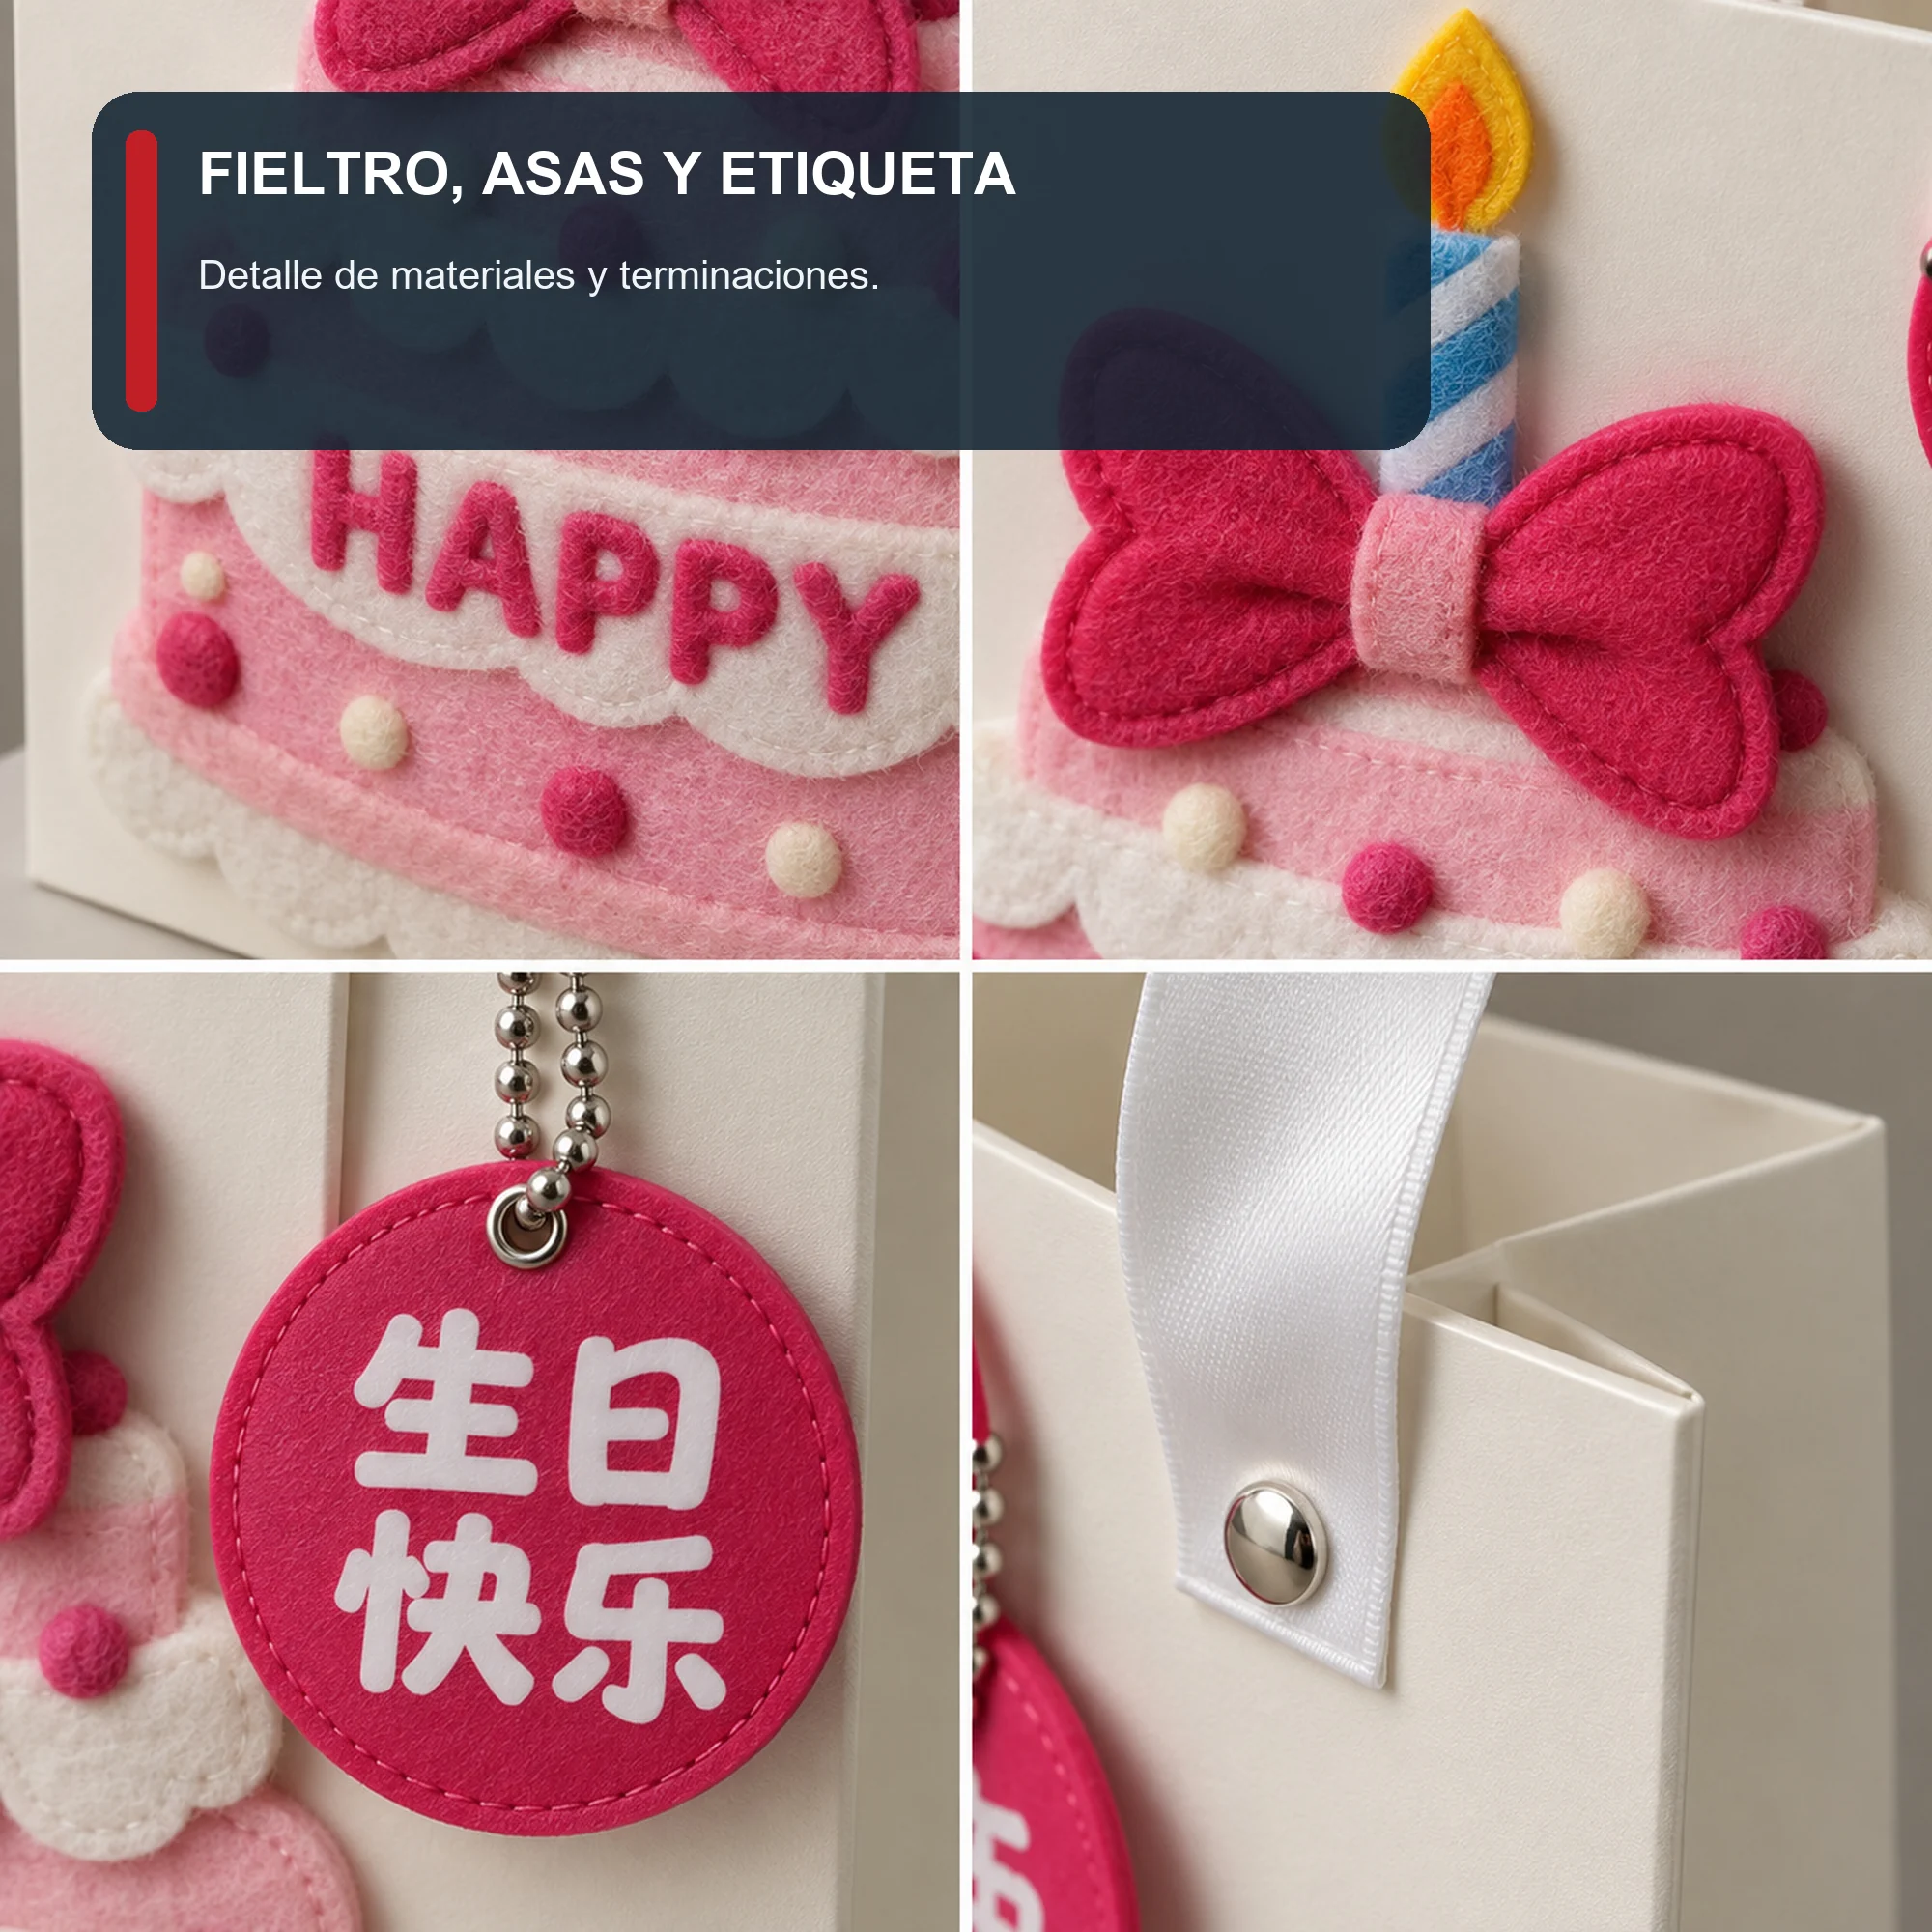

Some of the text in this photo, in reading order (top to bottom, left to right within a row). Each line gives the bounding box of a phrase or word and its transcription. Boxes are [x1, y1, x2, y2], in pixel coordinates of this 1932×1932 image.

[310, 437, 921, 716] HAPPY
[354, 1308, 722, 1511] 生日
[334, 1508, 727, 1725] 快乐
